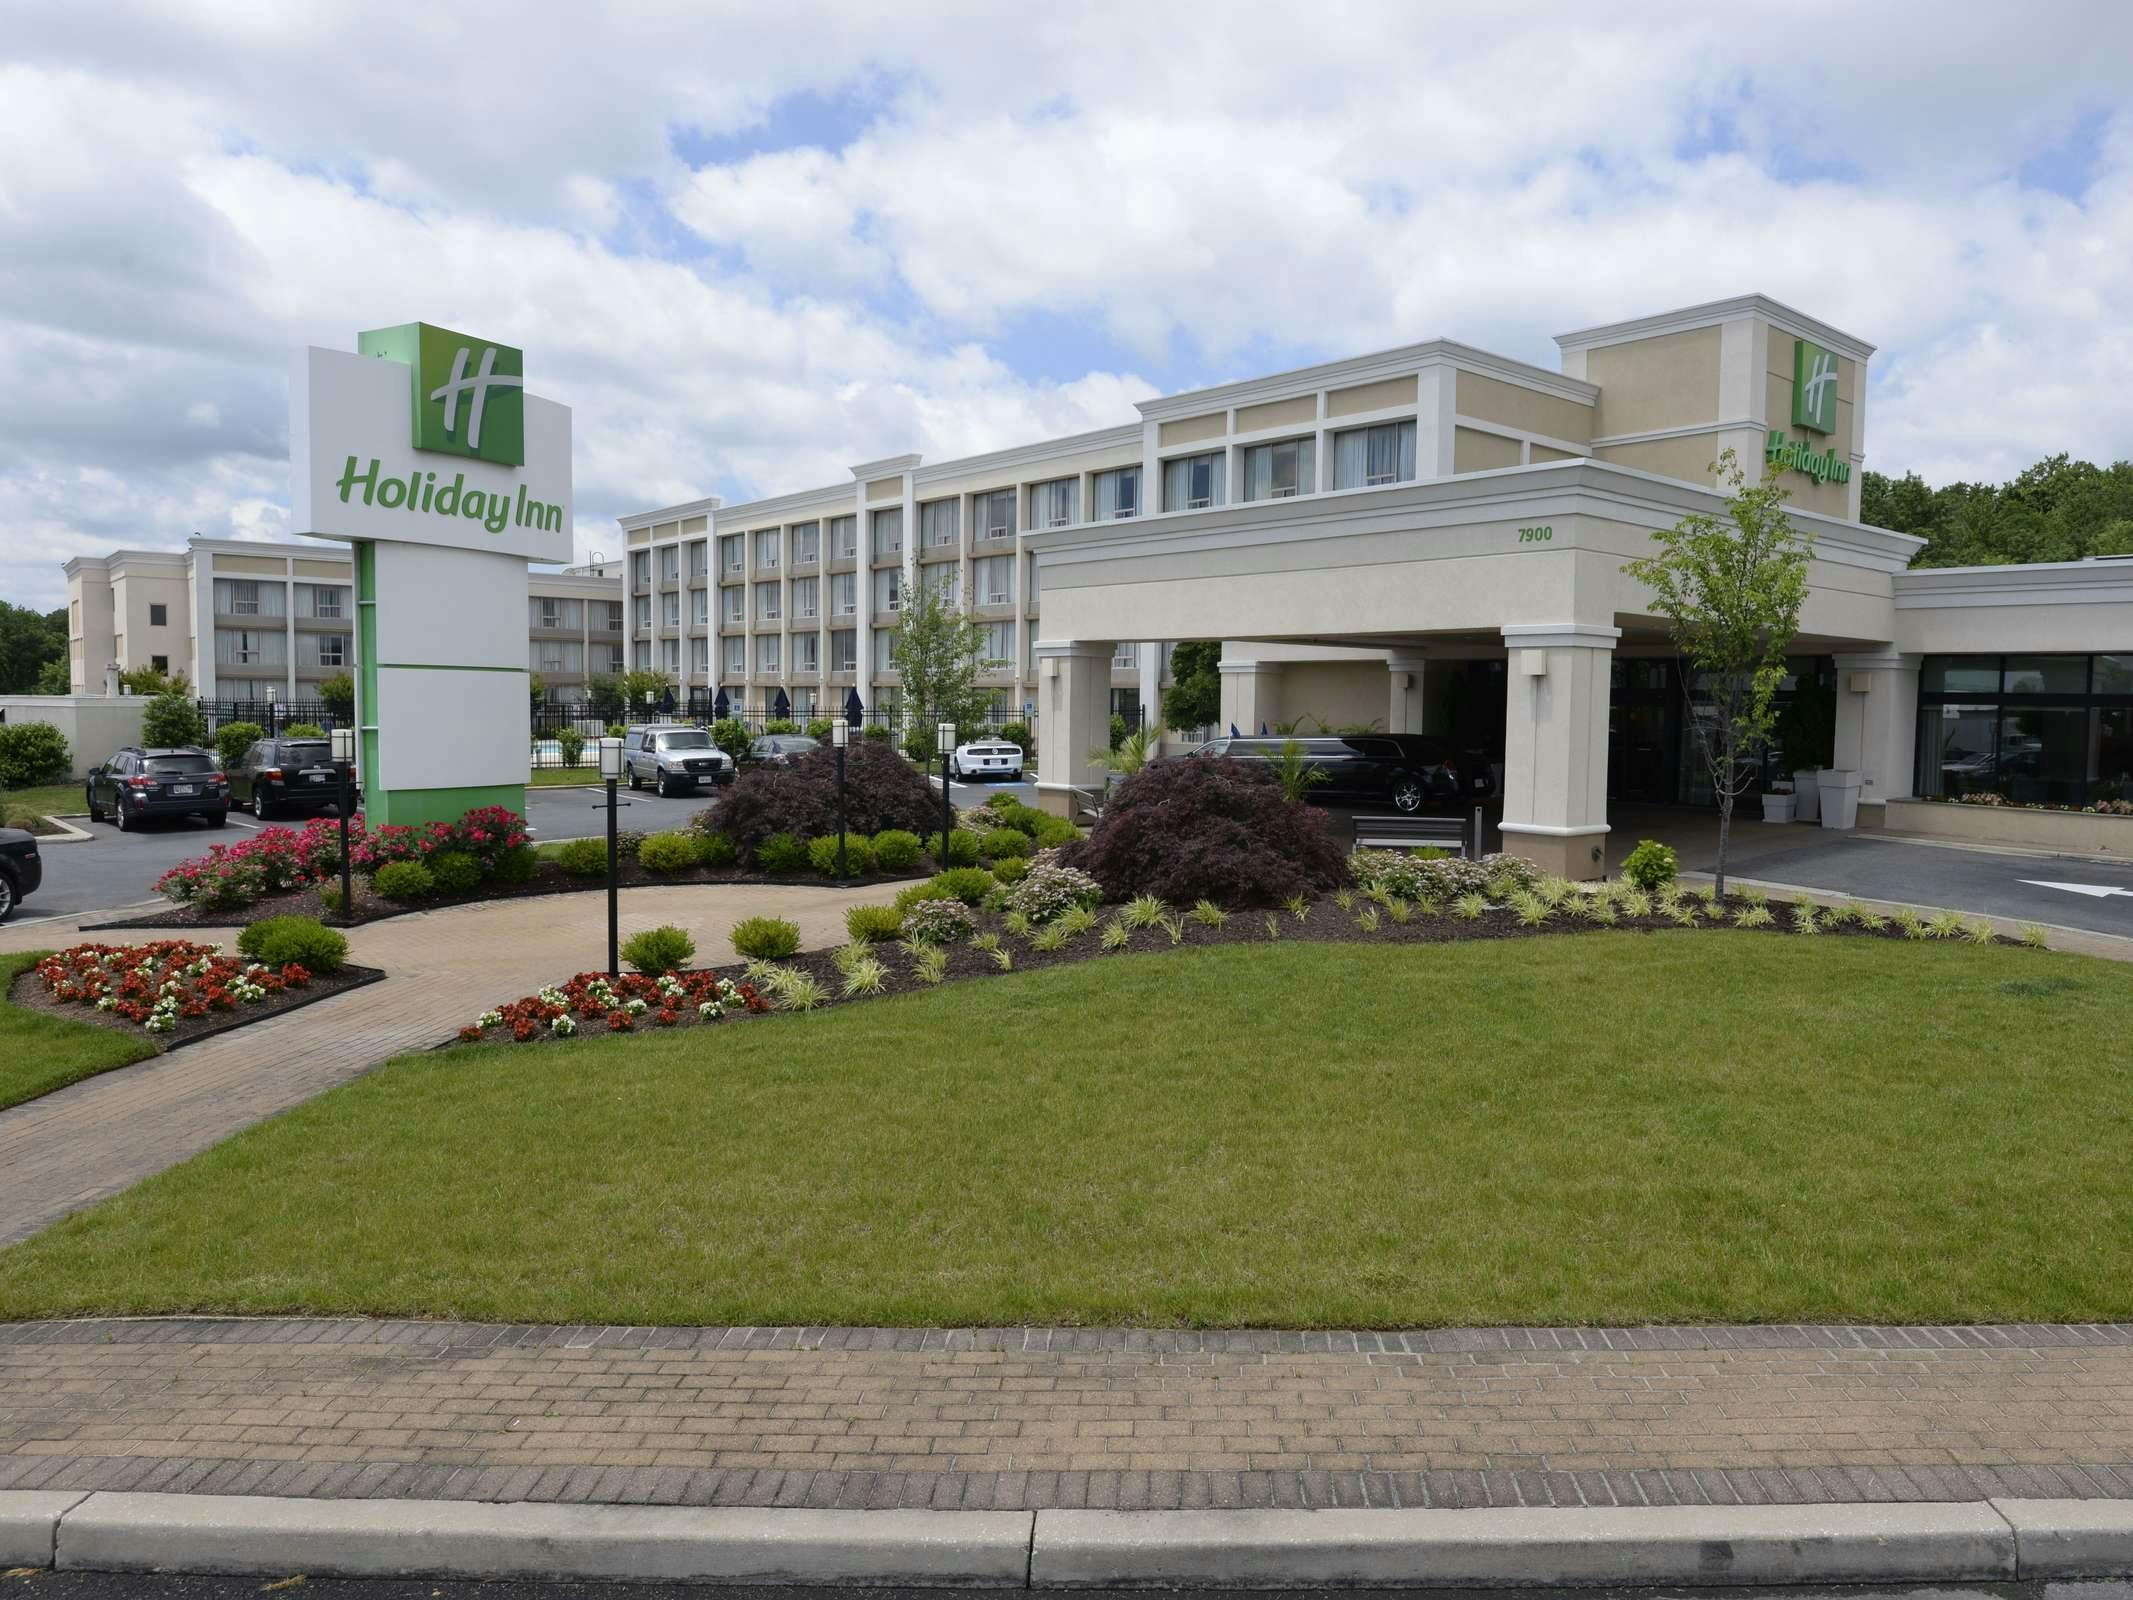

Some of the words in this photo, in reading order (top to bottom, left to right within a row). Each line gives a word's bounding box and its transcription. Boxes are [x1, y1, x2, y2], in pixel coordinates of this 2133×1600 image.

[430, 346, 523, 449] H
[1766, 431, 1830, 485] Holiday
[1828, 447, 1852, 484] Inn
[335, 455, 511, 534] Holiday
[515, 483, 563, 533] Inn
[1518, 526, 1553, 543] 7900
